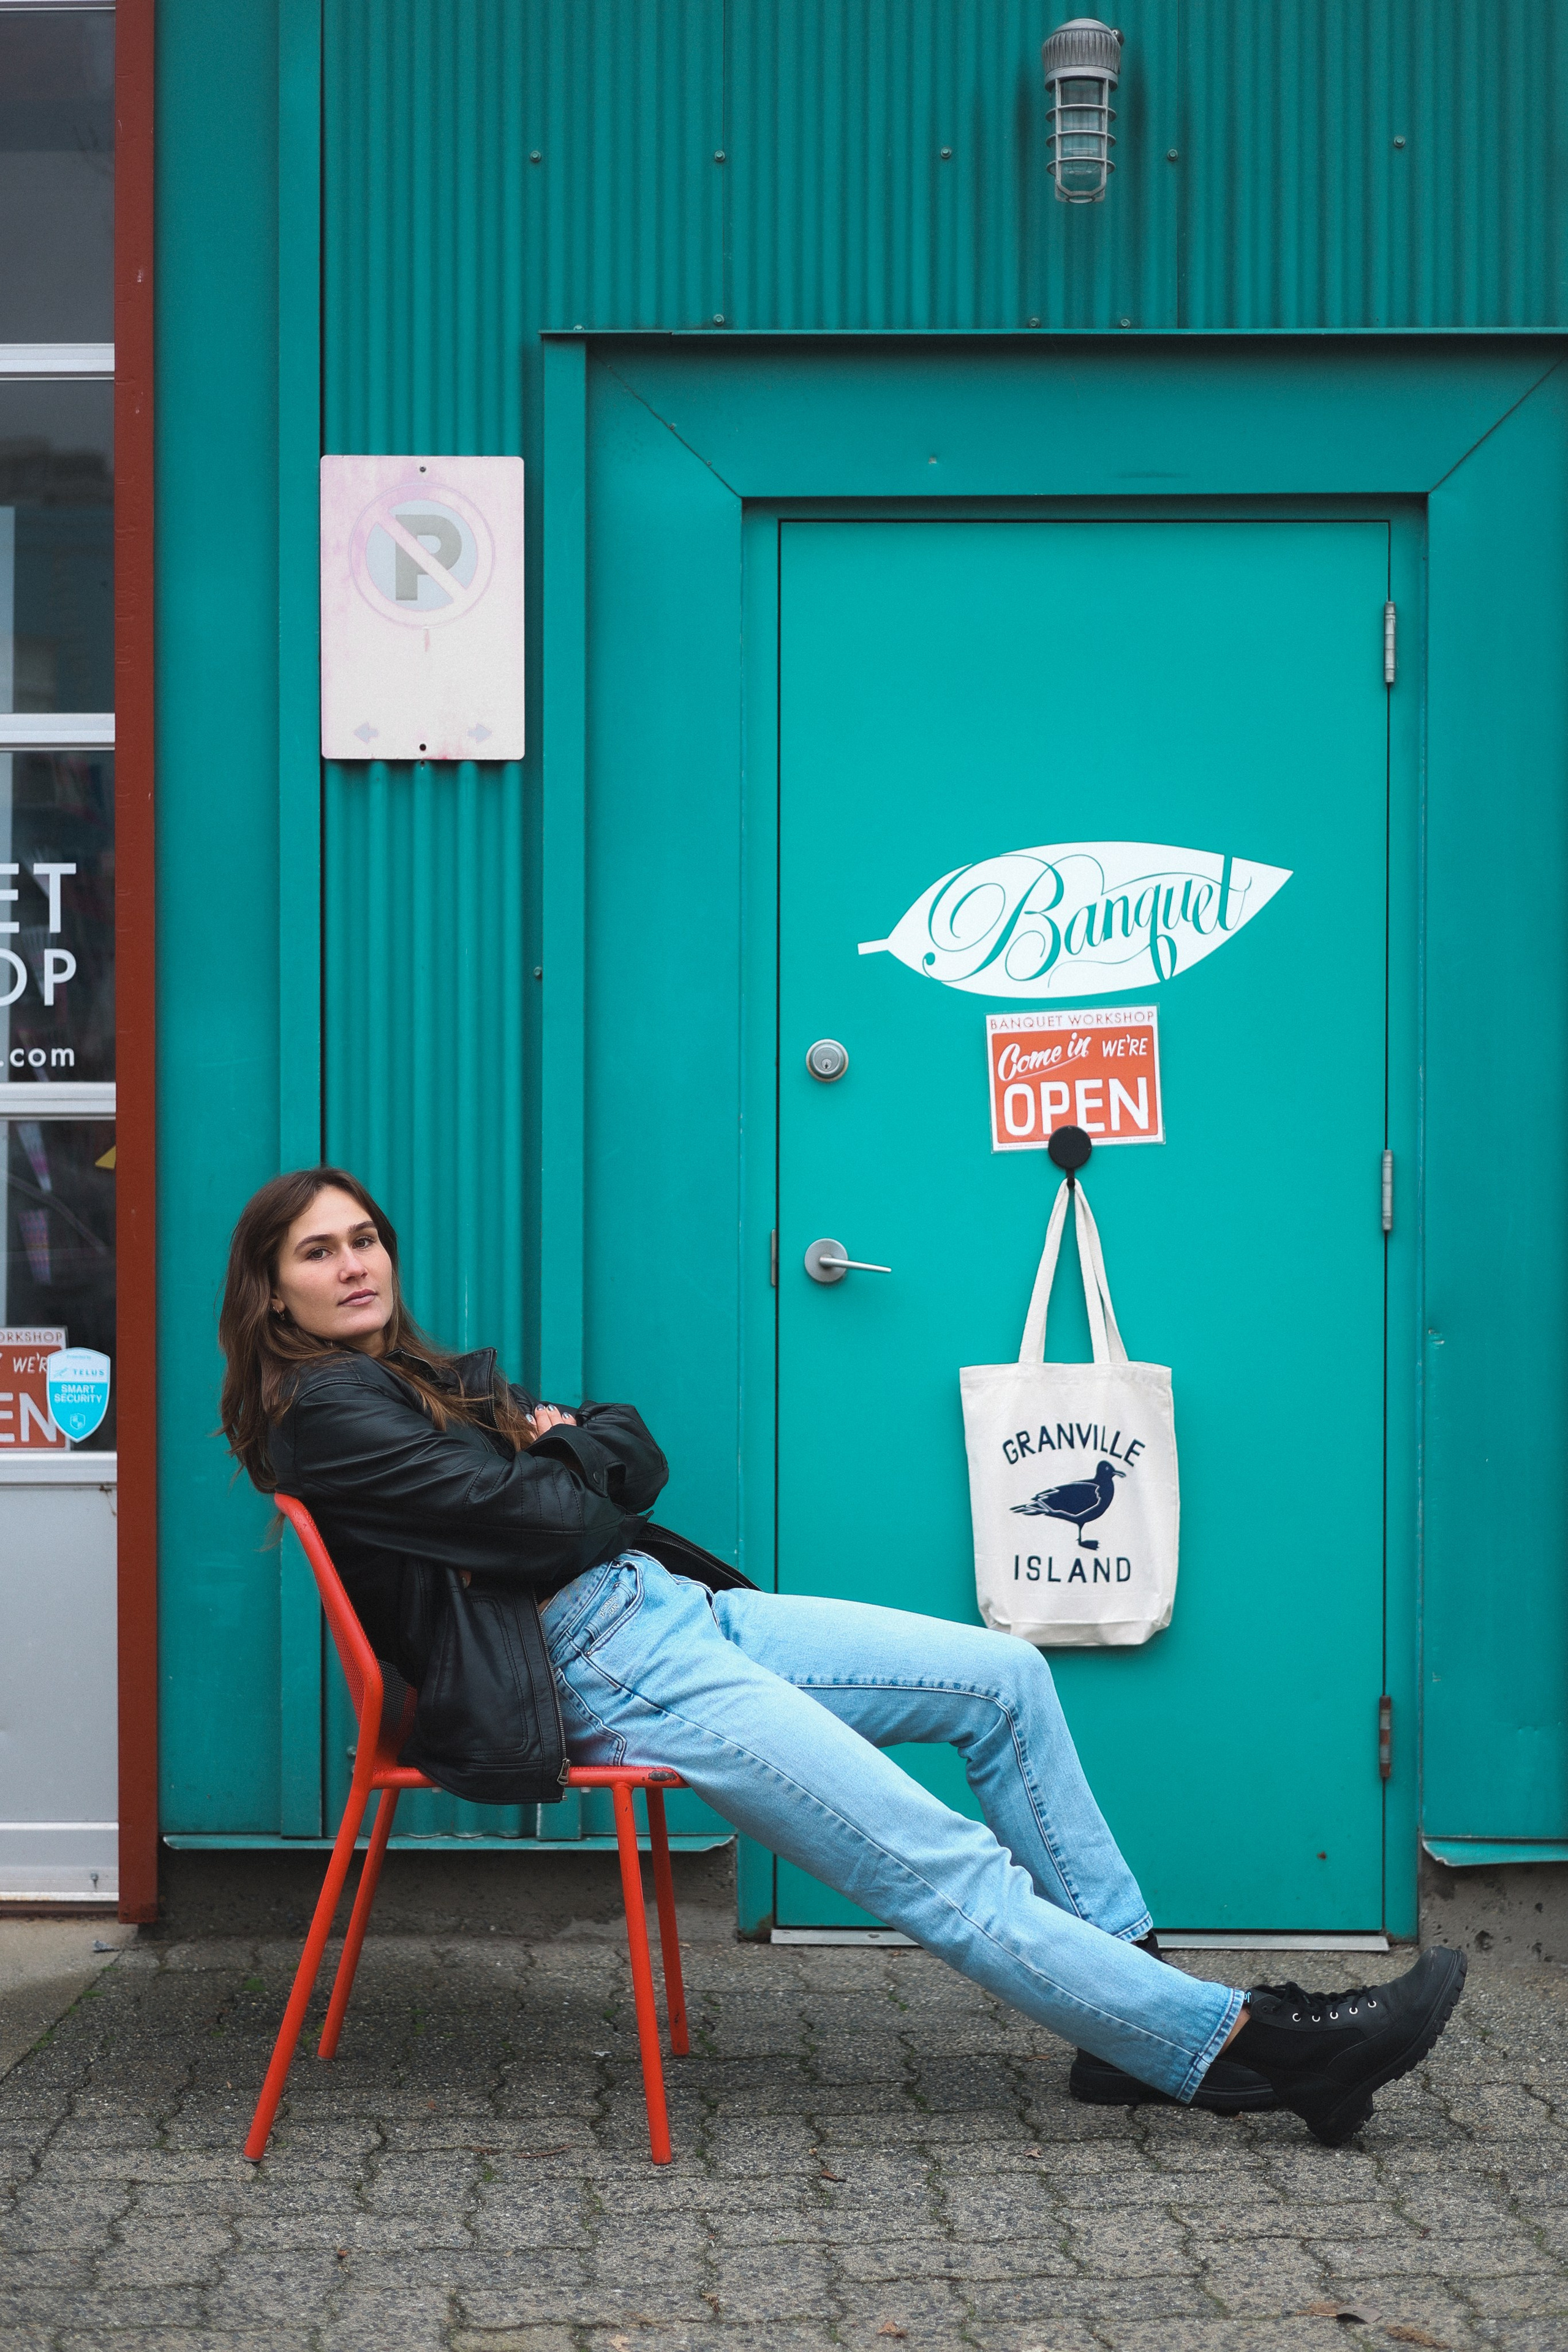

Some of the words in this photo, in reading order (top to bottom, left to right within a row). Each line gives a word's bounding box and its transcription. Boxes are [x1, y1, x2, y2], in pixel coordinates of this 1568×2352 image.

[922, 853, 1252, 986] Banquet
[990, 1015, 1063, 1030] BANQUET
[1068, 1011, 1154, 1025] WORKSHOP
[998, 1042, 1063, 1081] Come
[1067, 1031, 1091, 1058] in
[1102, 1033, 1148, 1058] WE'RE
[1003, 1077, 1149, 1137] OPEN
[54, 1393, 102, 1403] SECURITY
[61, 1384, 96, 1393] SMART
[1002, 1423, 1145, 1467] GRANVILLE
[1014, 1555, 1131, 1583] ISLAND
